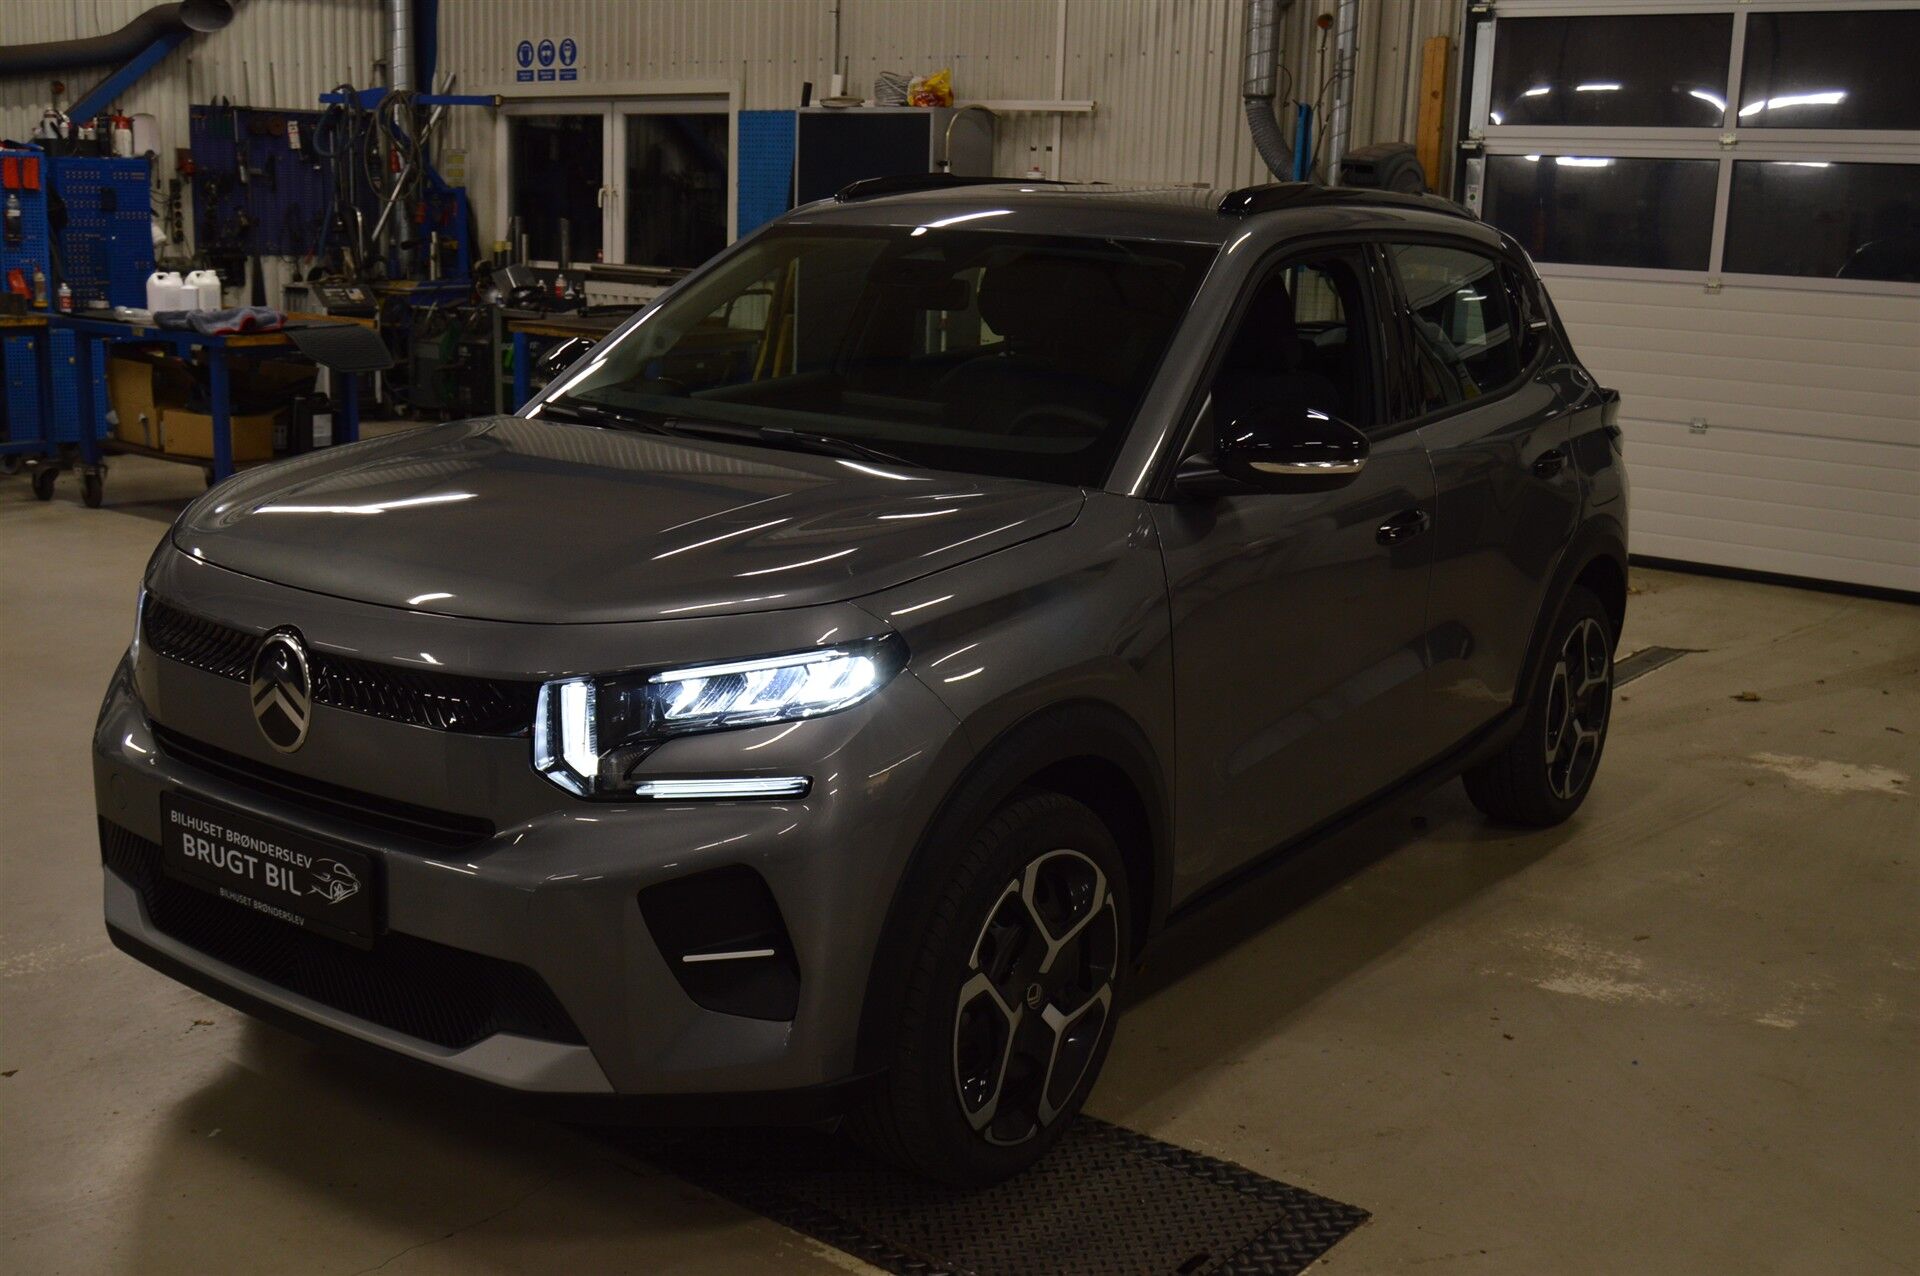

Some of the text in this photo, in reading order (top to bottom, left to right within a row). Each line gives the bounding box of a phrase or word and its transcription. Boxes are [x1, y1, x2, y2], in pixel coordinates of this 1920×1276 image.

[170, 810, 312, 868] BILHUSET BRØNDERSLEV
[183, 833, 301, 896] BRUGT BIL
[219, 887, 305, 926] BILHUSET BRØNDERSLEV
